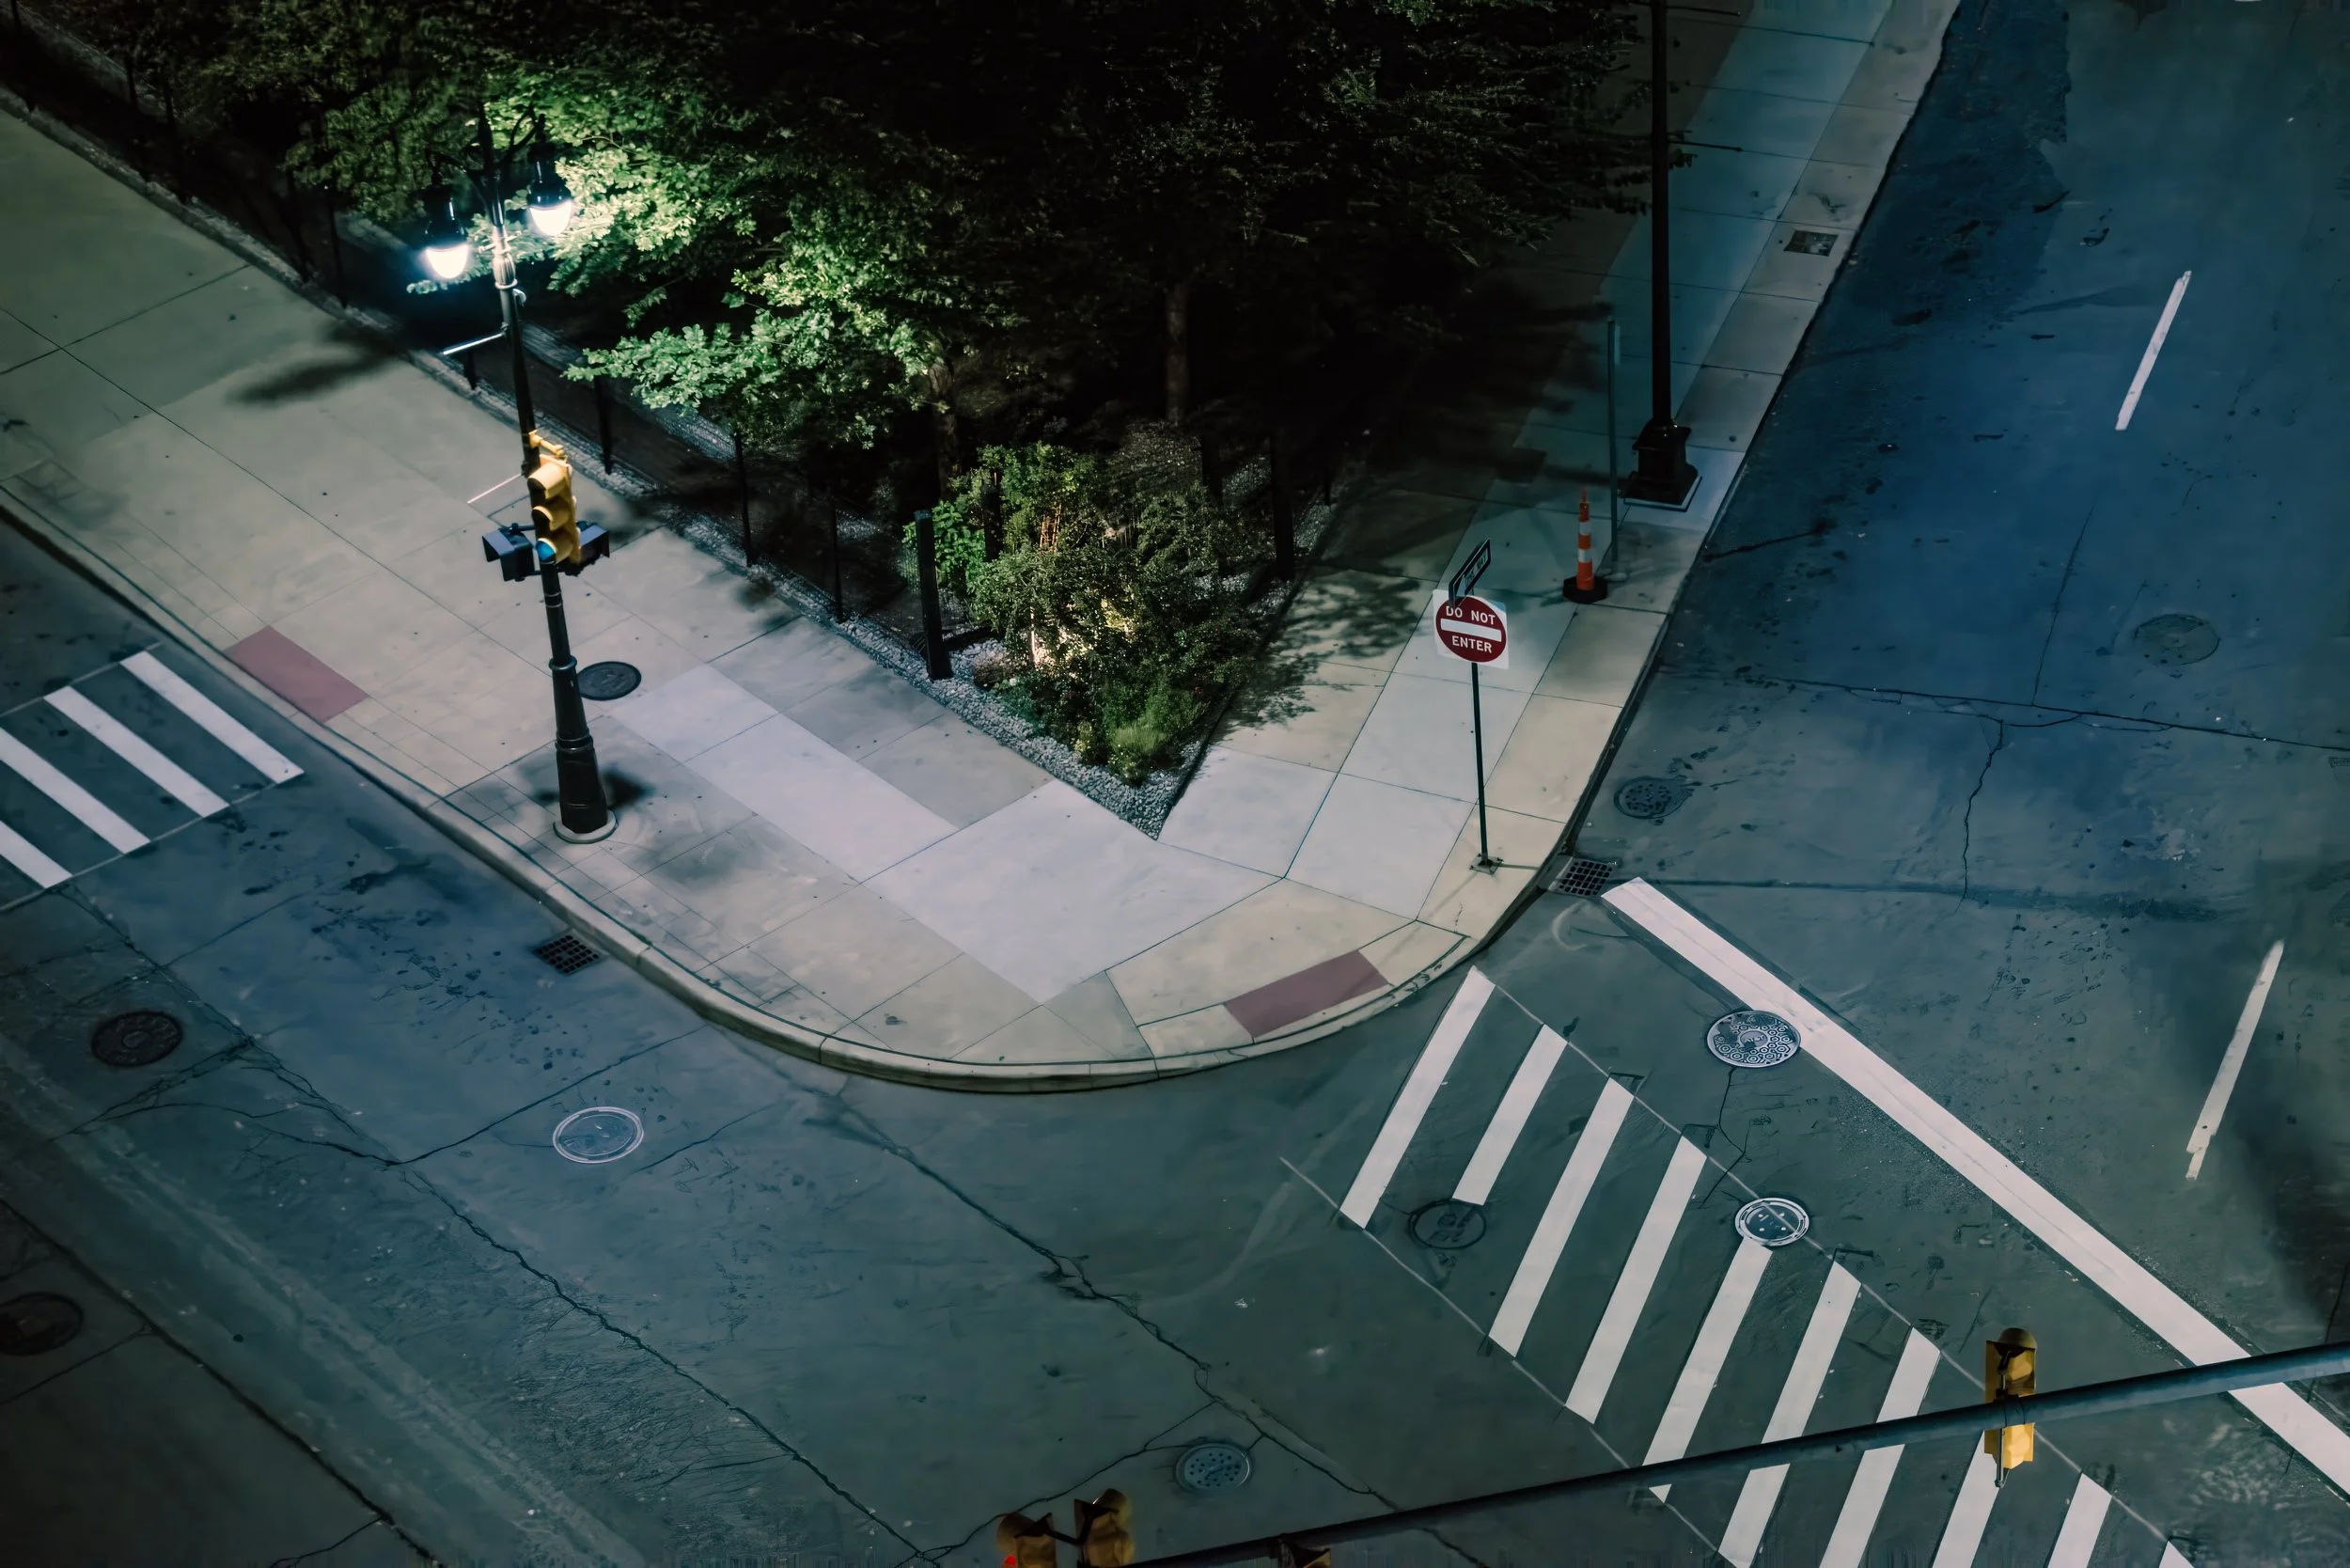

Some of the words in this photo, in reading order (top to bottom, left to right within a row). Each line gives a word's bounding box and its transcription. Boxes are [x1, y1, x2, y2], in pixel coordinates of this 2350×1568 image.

[1446, 605, 1463, 619] DO
[1471, 610, 1496, 625] NOT
[1451, 635, 1493, 653] ENTER
